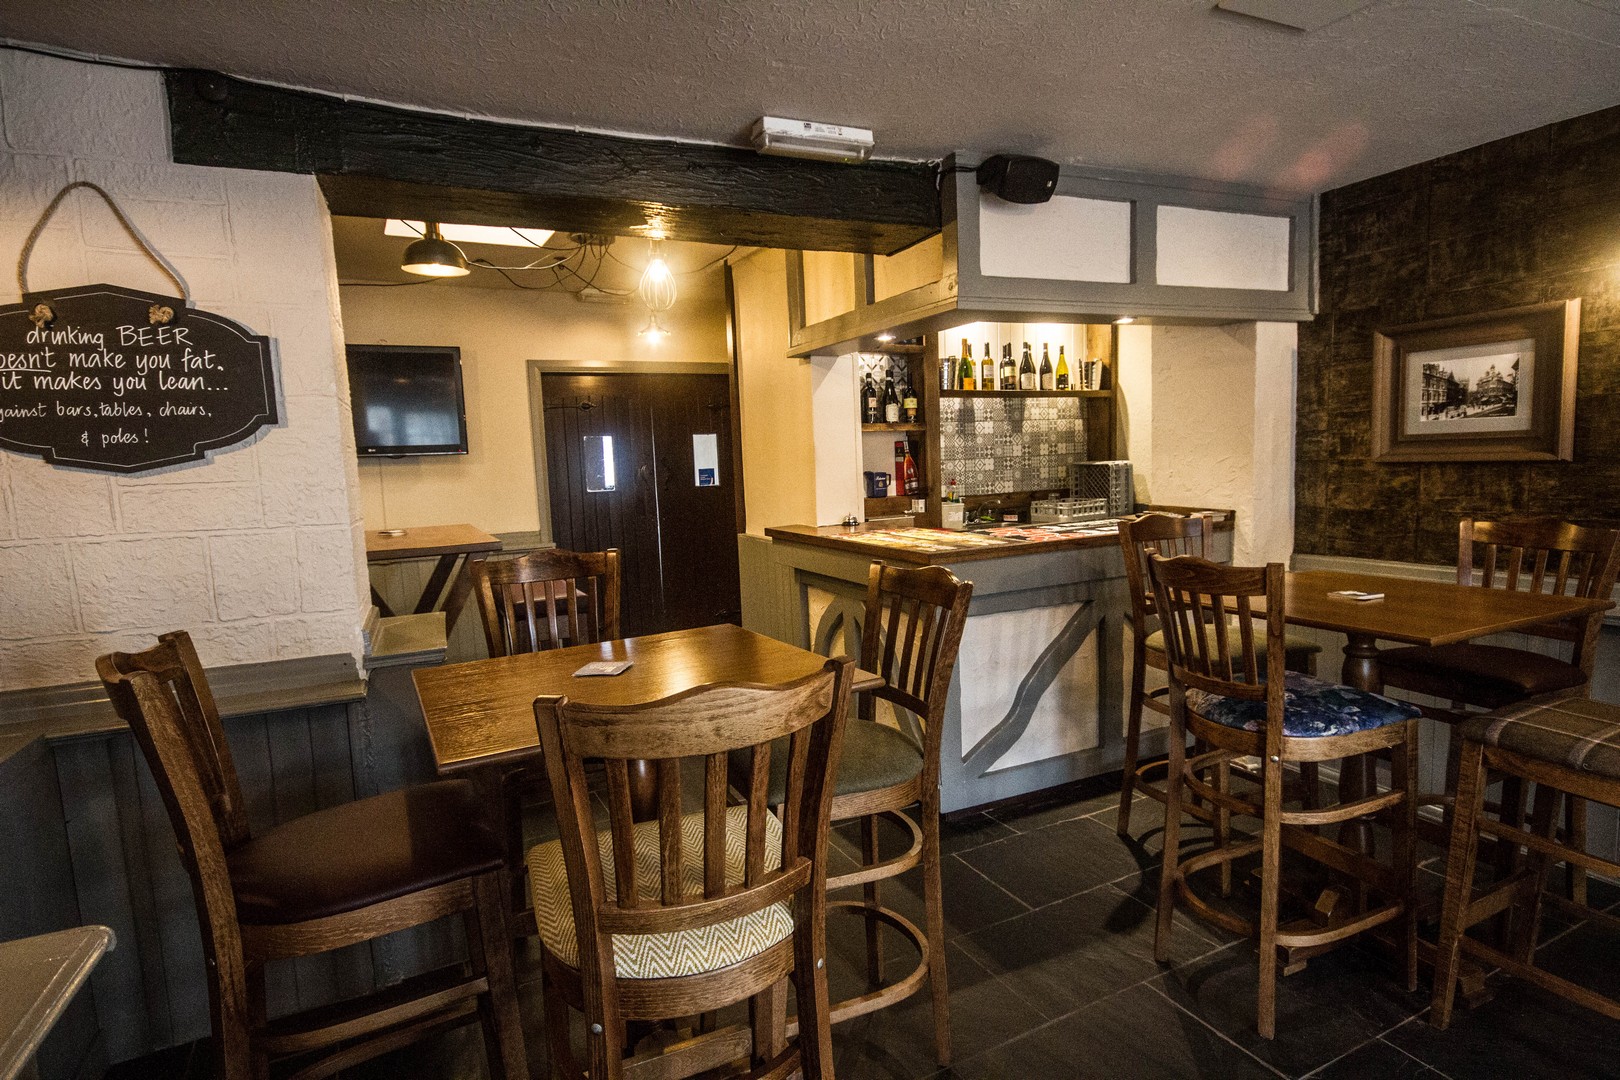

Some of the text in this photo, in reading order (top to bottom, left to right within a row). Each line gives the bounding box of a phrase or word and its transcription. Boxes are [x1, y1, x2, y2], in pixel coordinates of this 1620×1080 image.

[26, 324, 194, 352] drinking BEER
[69, 347, 126, 369] make
[135, 353, 172, 376] you
[1, 369, 229, 397] it makes you lean...
